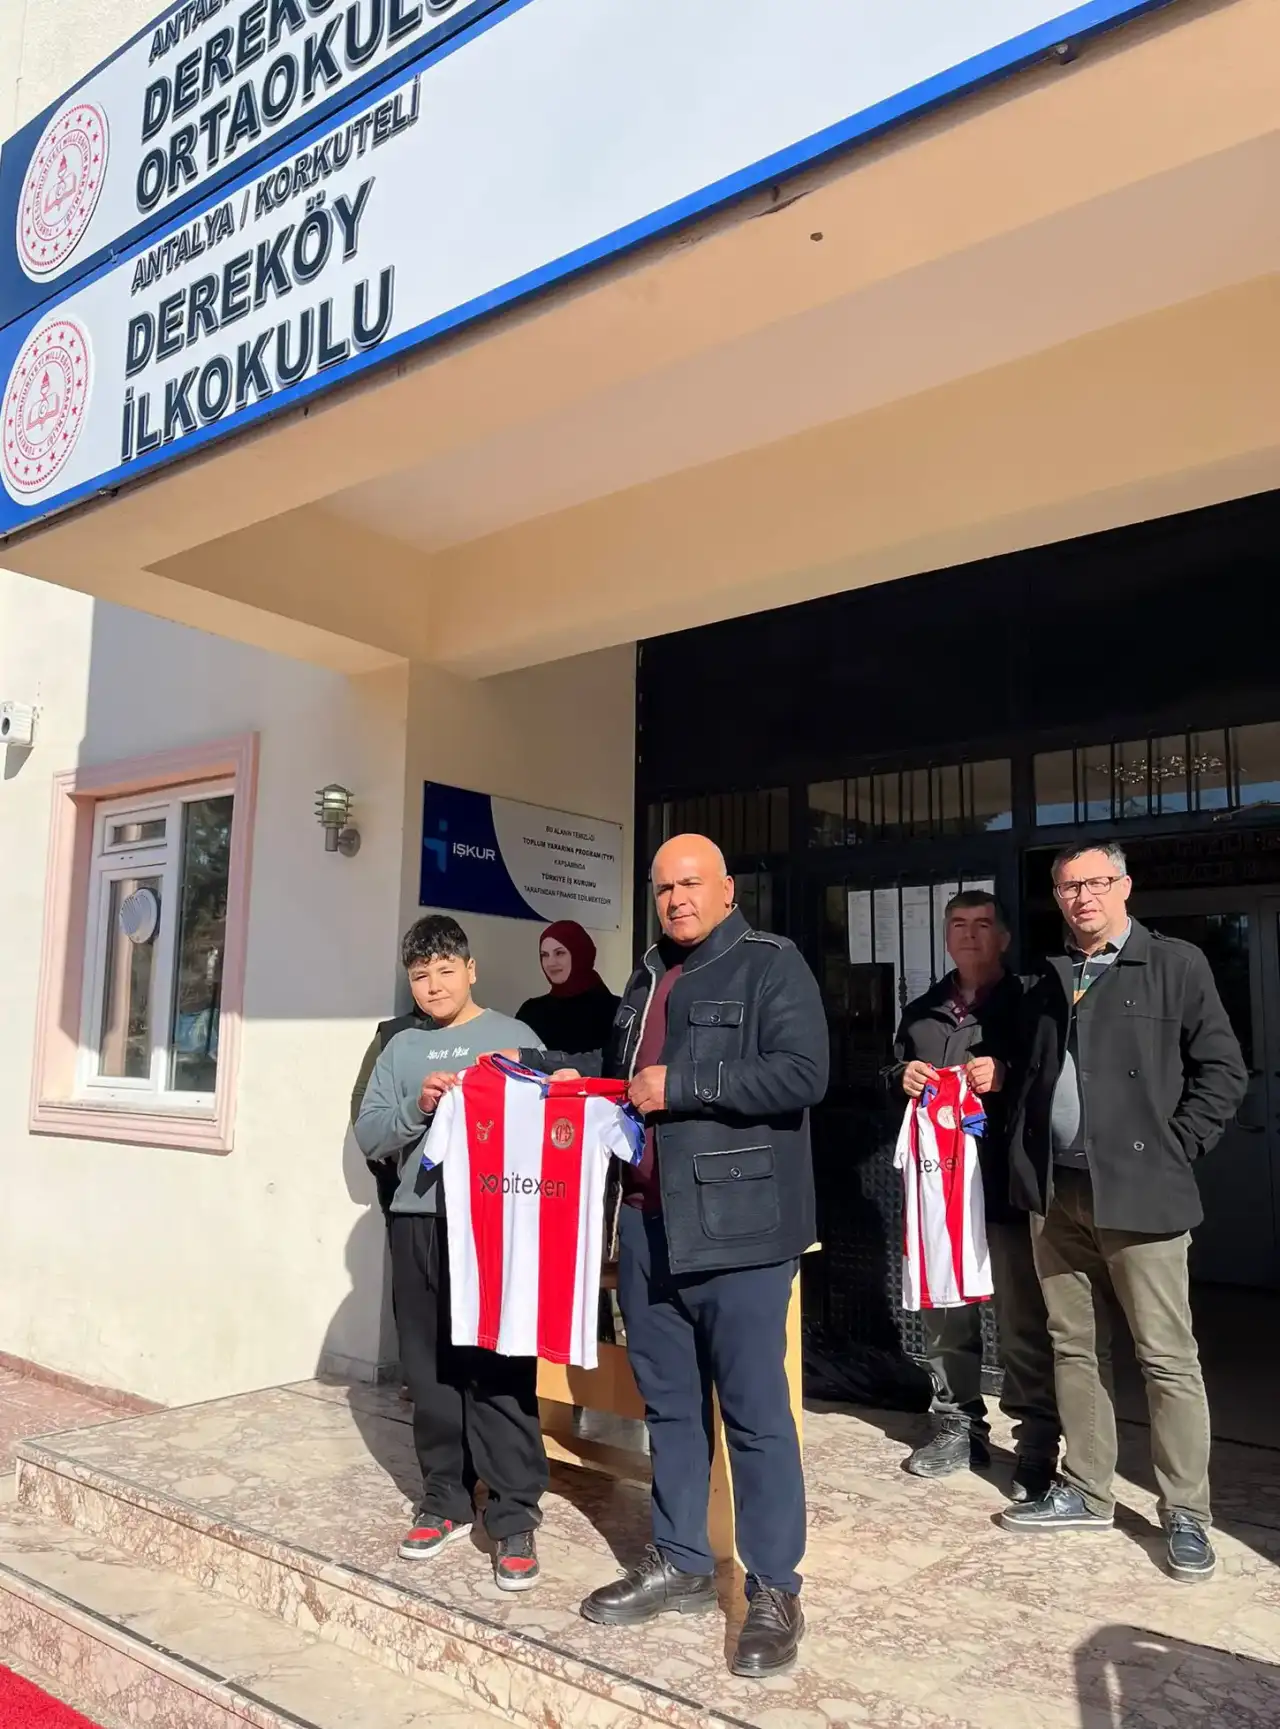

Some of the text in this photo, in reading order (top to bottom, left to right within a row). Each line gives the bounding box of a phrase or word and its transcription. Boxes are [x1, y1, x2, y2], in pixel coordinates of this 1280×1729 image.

[148, 0, 230, 66] ANTAL
[141, 0, 329, 145] DEREK
[136, 0, 458, 214] ORTAOKUL
[131, 73, 420, 297] ANTALYA / KORKUTELİ
[125, 176, 376, 380] DEREKÖY
[121, 264, 395, 465] İLKOKULU
[452, 842, 496, 861] İŞKUR
[522, 837, 615, 863] TOPLUM YARARINA PROGRAM (TYP)
[541, 872, 597, 889] TÜRKİYE İŞ KURUMU
[523, 885, 556, 897] TARAFINDAN
[501, 1172, 566, 1198] bitexen
